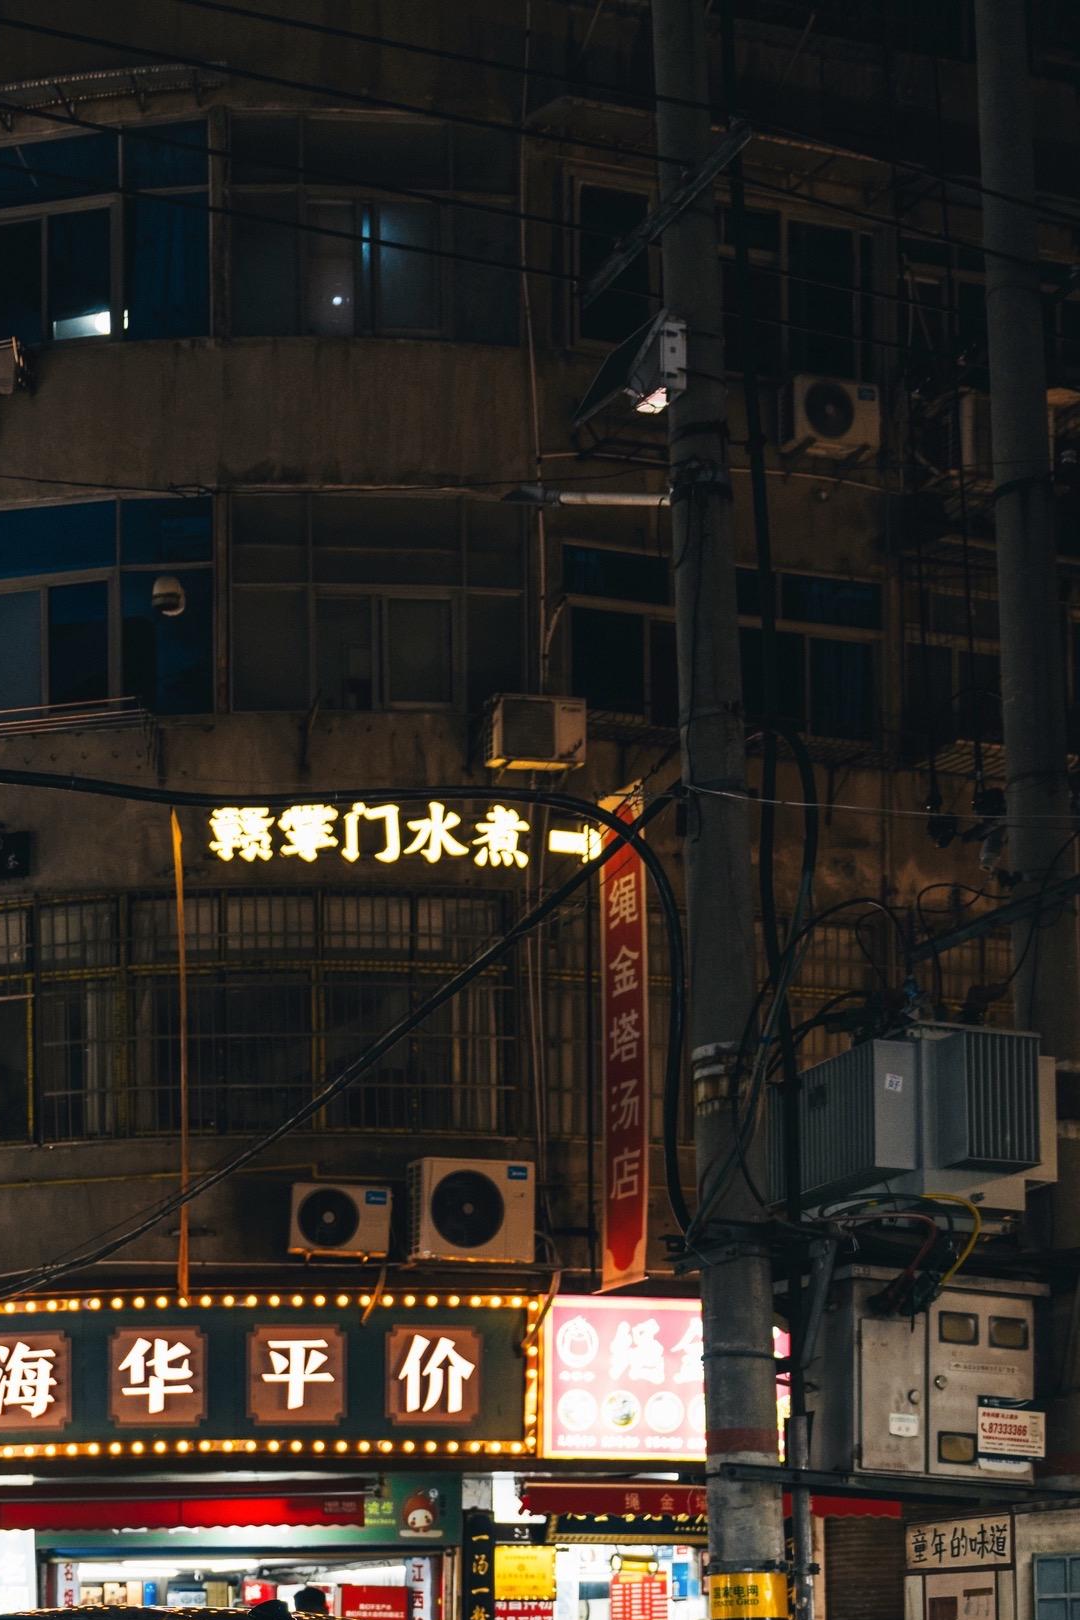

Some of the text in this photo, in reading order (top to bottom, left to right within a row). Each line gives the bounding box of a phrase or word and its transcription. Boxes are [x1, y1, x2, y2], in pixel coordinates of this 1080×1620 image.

[609, 871, 641, 1200] 绳金塔汤店
[988, 1422, 1028, 1437] 87333366
[911, 1523, 1008, 1563] 童年的味道
